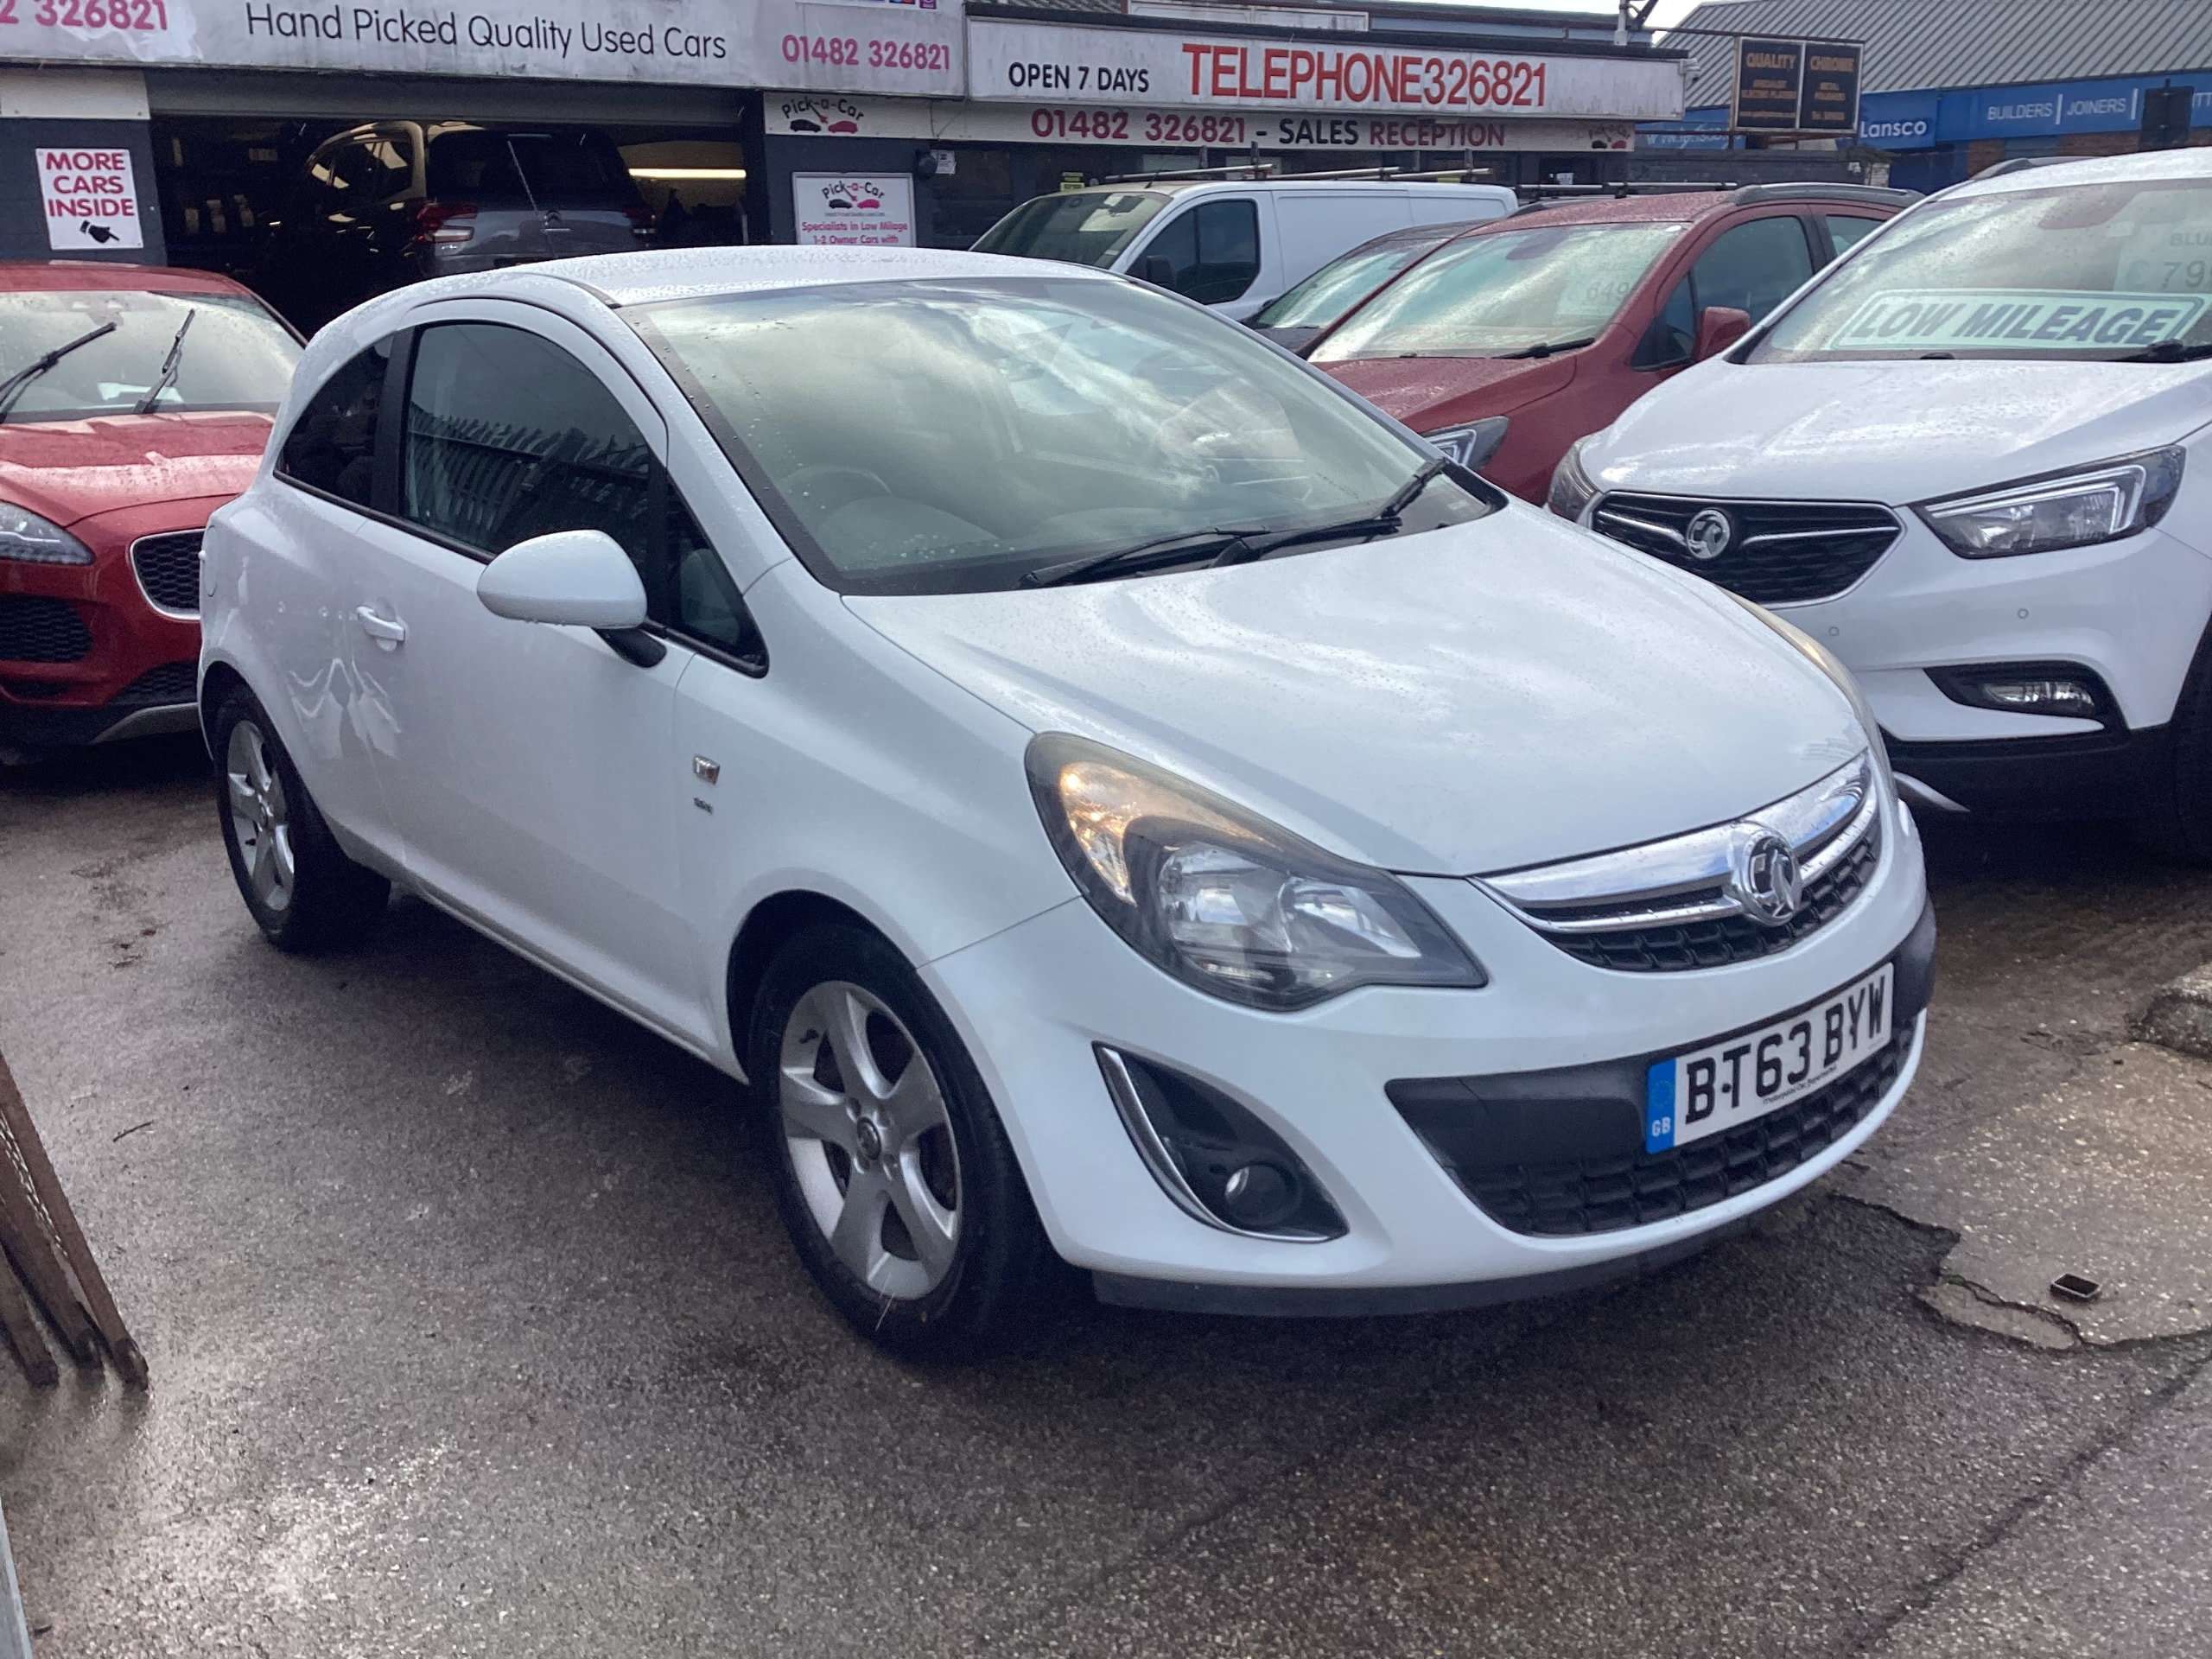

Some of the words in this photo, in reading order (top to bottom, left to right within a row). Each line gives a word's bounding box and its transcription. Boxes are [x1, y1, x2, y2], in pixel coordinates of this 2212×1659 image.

[35, 0, 168, 30] 326821
[245, 3, 342, 40] Hand
[353, 9, 457, 45] Picked
[468, 16, 572, 59] Quality
[582, 22, 655, 55] Used
[664, 27, 727, 59] Cars
[782, 35, 859, 65] 01482
[868, 40, 950, 70] 326821
[1746, 53, 1796, 69] QUALITY
[1008, 61, 1071, 89] OPEN
[1077, 66, 1090, 88] 7
[1098, 67, 1149, 92] DAYS
[1182, 43, 1547, 107] TELEPHONE326821
[1988, 103, 2054, 121] BUILDERS
[2066, 98, 2127, 117] JOINERS
[1031, 108, 1129, 139] 01482
[1145, 113, 1245, 143] 326821
[1279, 118, 1359, 145] SALES
[1370, 120, 1505, 147] RECEPTION
[1859, 119, 1928, 139] Lansco
[46, 151, 126, 171] MORE
[54, 175, 124, 194] CARS
[822, 180, 886, 200] Pick-a-Car
[48, 198, 136, 218] INSIDE
[802, 221, 848, 232] Specialists
[850, 221, 859, 231] in
[861, 221, 877, 231] Low
[830, 235, 858, 245] Owner
[861, 235, 879, 244] Cars
[881, 234, 899, 244] with
[2170, 231, 2212, 246] BLU
[1851, 302, 1967, 339] LOW
[1951, 303, 2182, 345] MILEAGE
[1685, 1020, 1812, 1125] BT63
[1823, 976, 1885, 1070] BYW
[1651, 1116, 1671, 1137] GB
